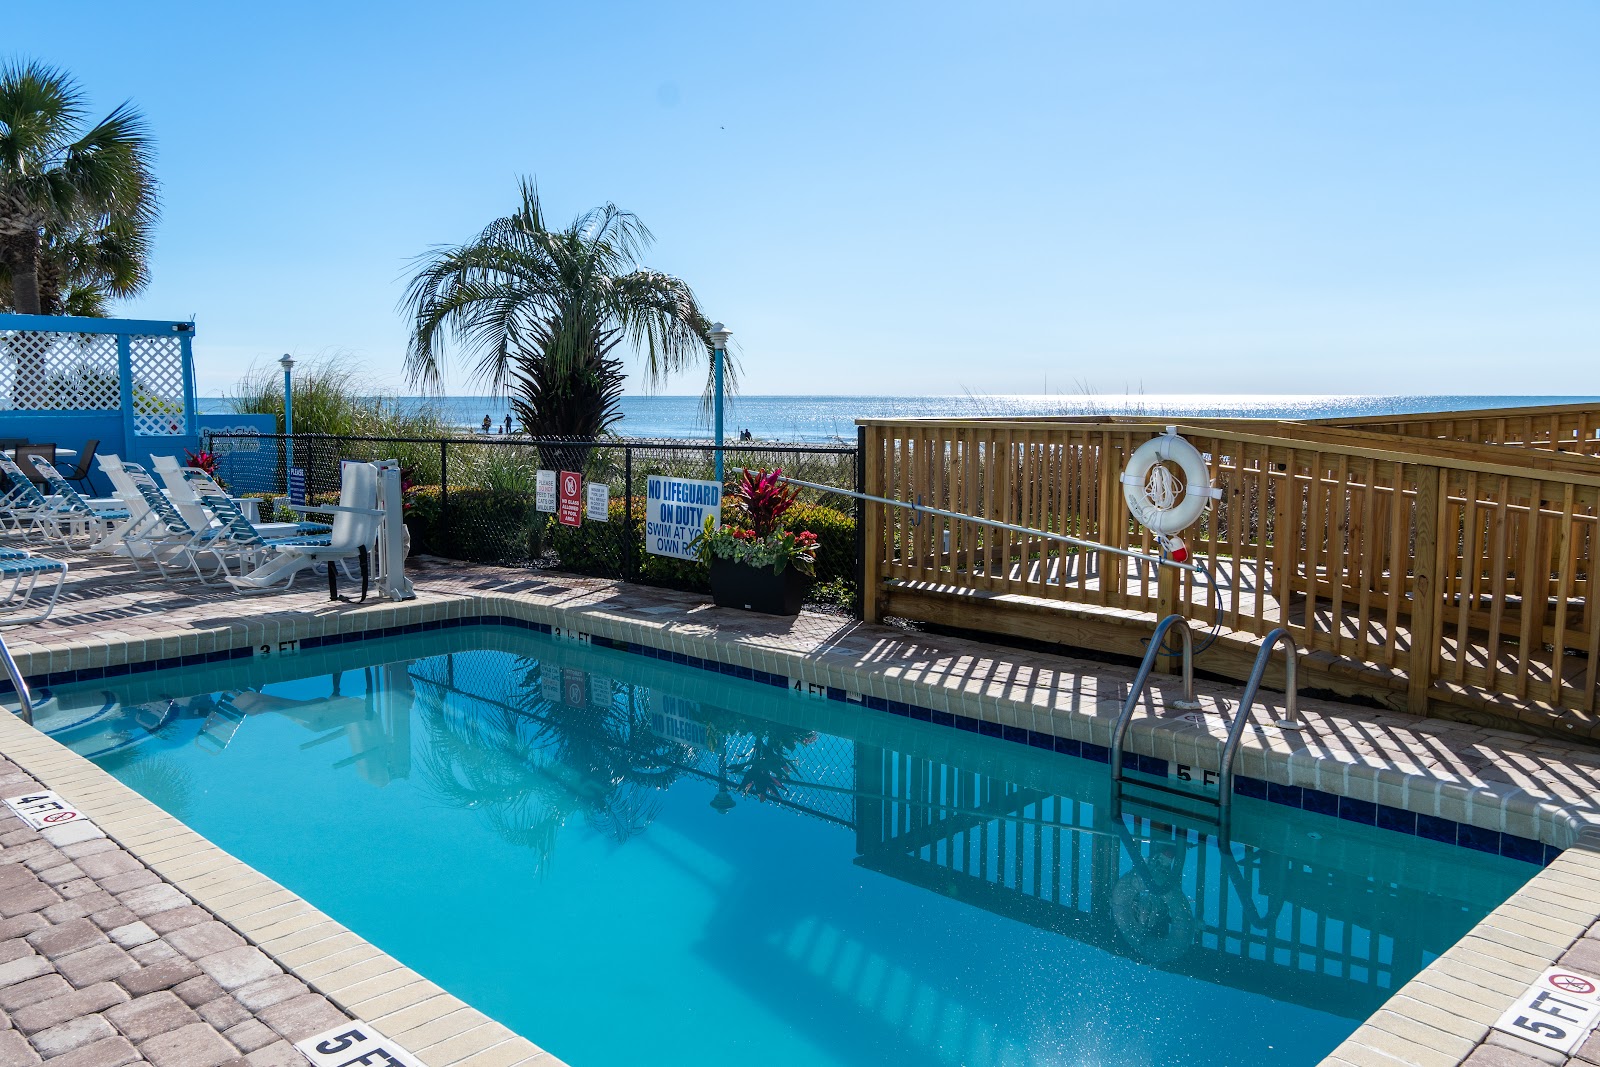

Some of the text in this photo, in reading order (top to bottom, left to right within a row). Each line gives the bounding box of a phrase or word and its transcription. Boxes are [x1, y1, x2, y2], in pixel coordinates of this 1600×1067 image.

[291, 468, 304, 477] PLEASE
[648, 479, 719, 507] NO LIFEGUARD
[660, 503, 704, 527] ON DUTY
[647, 521, 705, 543] SWIM AT YO
[657, 537, 702, 556] OWN RIS
[260, 639, 298, 654] 3 FT
[578, 631, 590, 643] FT
[808, 682, 825, 697] FT
[1177, 763, 1220, 786] 5 F
[16, 795, 65, 815] 4 FT
[1512, 990, 1589, 1040] 5 FT
[315, 1029, 368, 1055] 5
